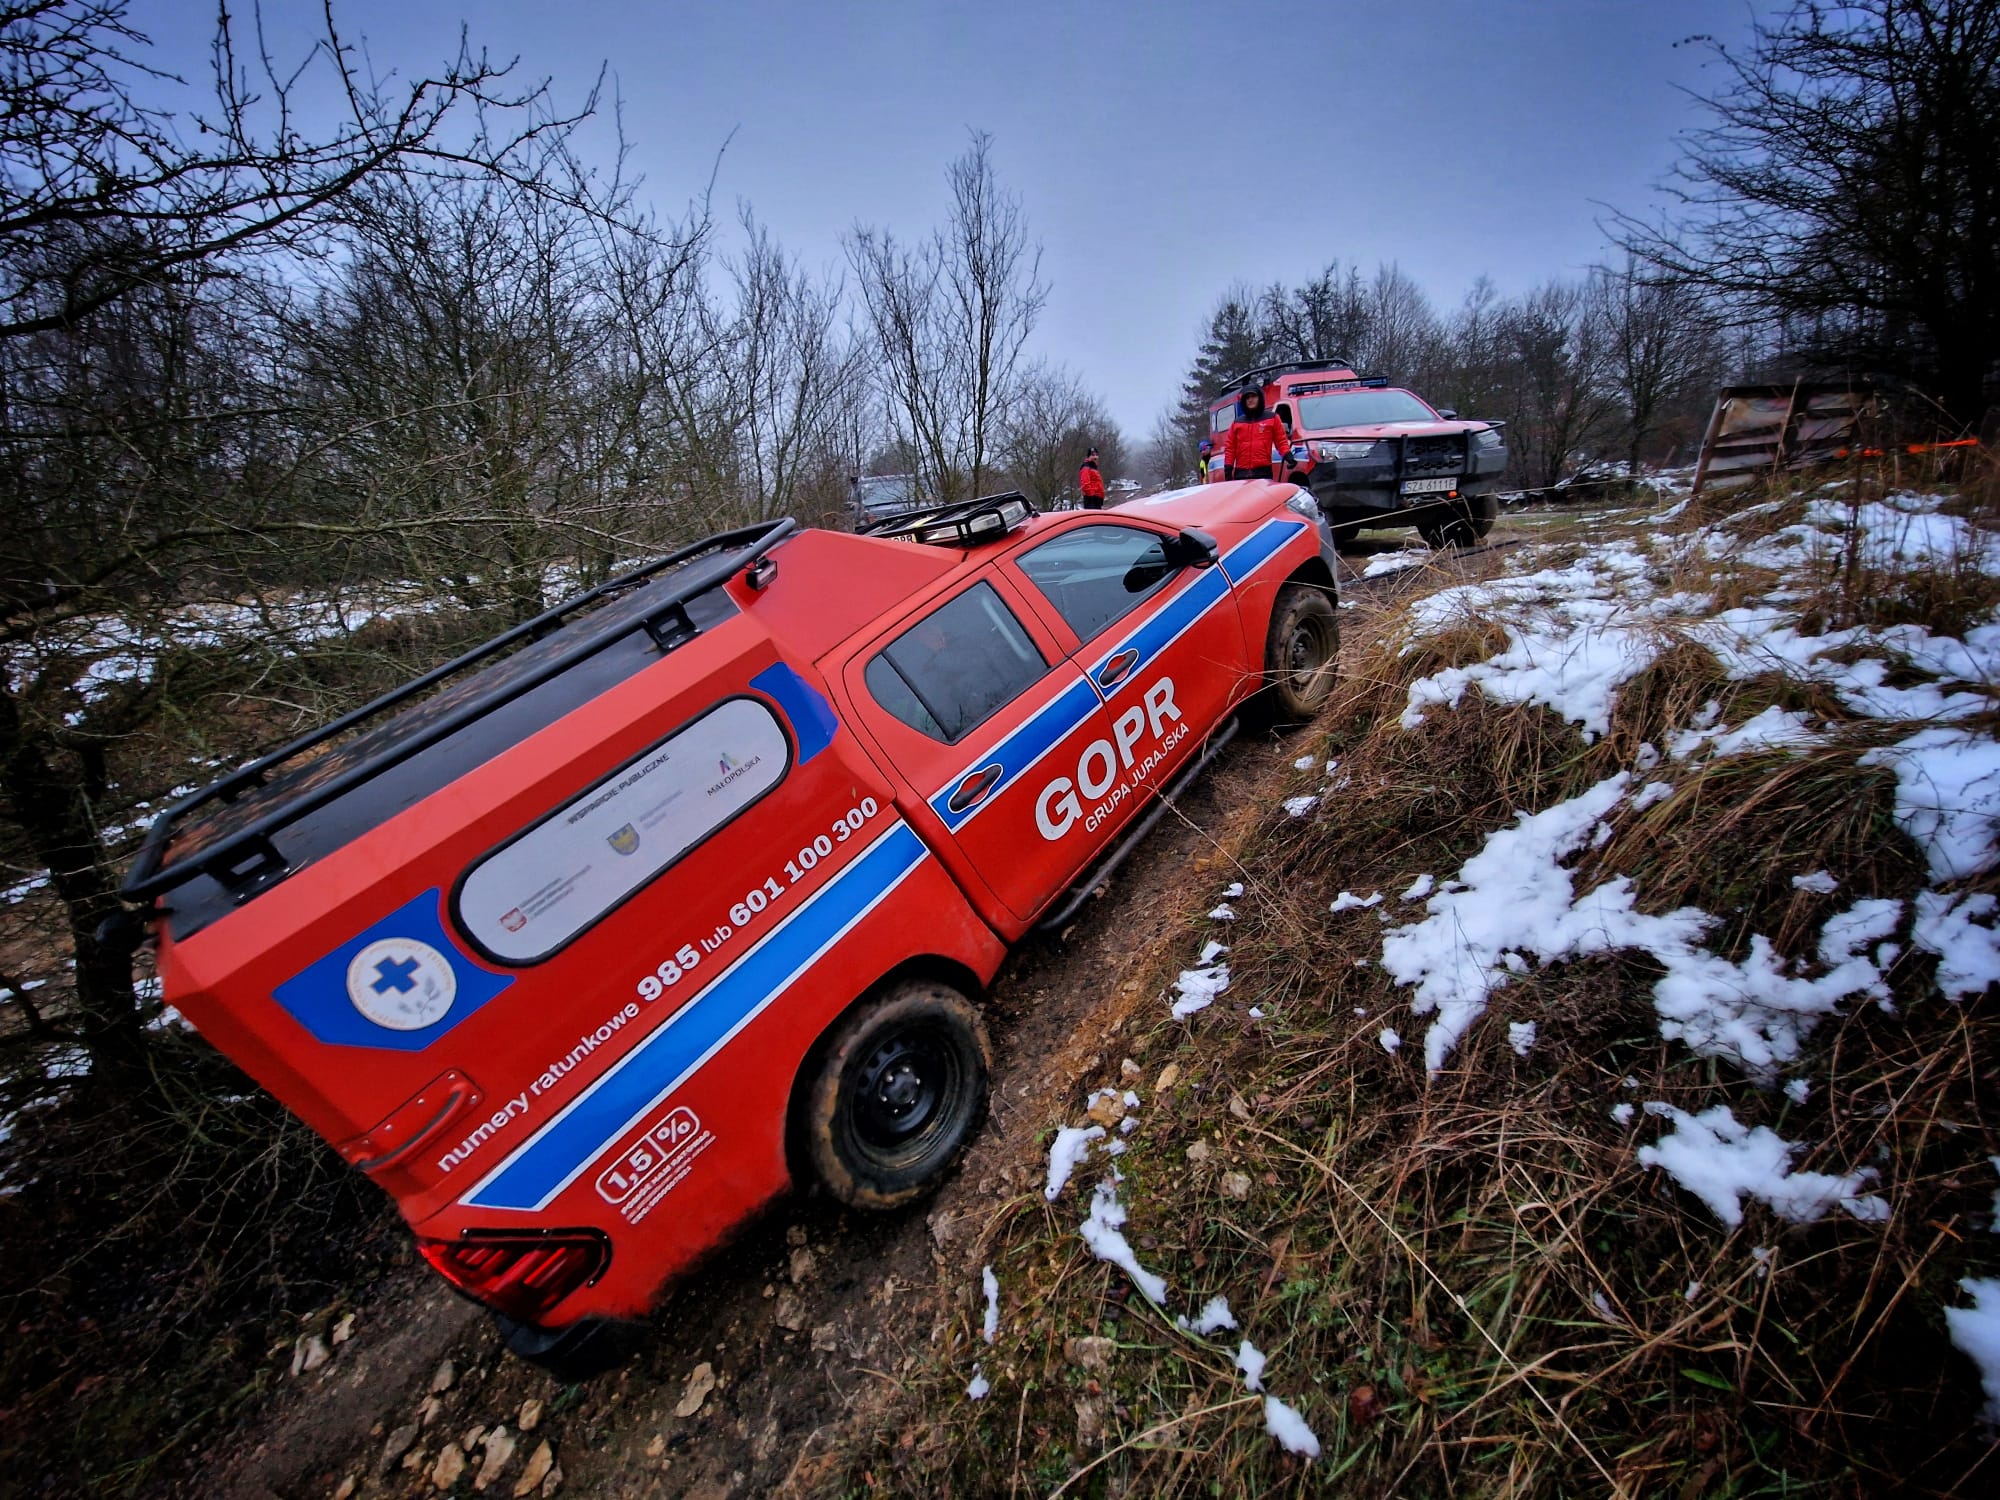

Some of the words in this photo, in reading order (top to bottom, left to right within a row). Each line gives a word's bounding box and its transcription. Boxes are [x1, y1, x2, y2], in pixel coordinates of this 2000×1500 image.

[1407, 481, 1423, 492] SZA
[618, 752, 670, 791] PUBLICZNE
[707, 755, 761, 797] MAŁOPOLSKA
[1035, 676, 1183, 841] GOPR
[1085, 782, 1132, 833] GRUPA
[1131, 722, 1190, 788] JURAJSKA
[437, 1092, 529, 1172] numery
[529, 1002, 640, 1096] ratunkowe
[637, 943, 701, 1001] 985
[700, 924, 733, 953] lub
[729, 876, 785, 927] 601
[783, 834, 833, 884] 100
[831, 796, 878, 842] 300
[607, 1148, 653, 1190] 1,5
[656, 1117, 692, 1144] %
